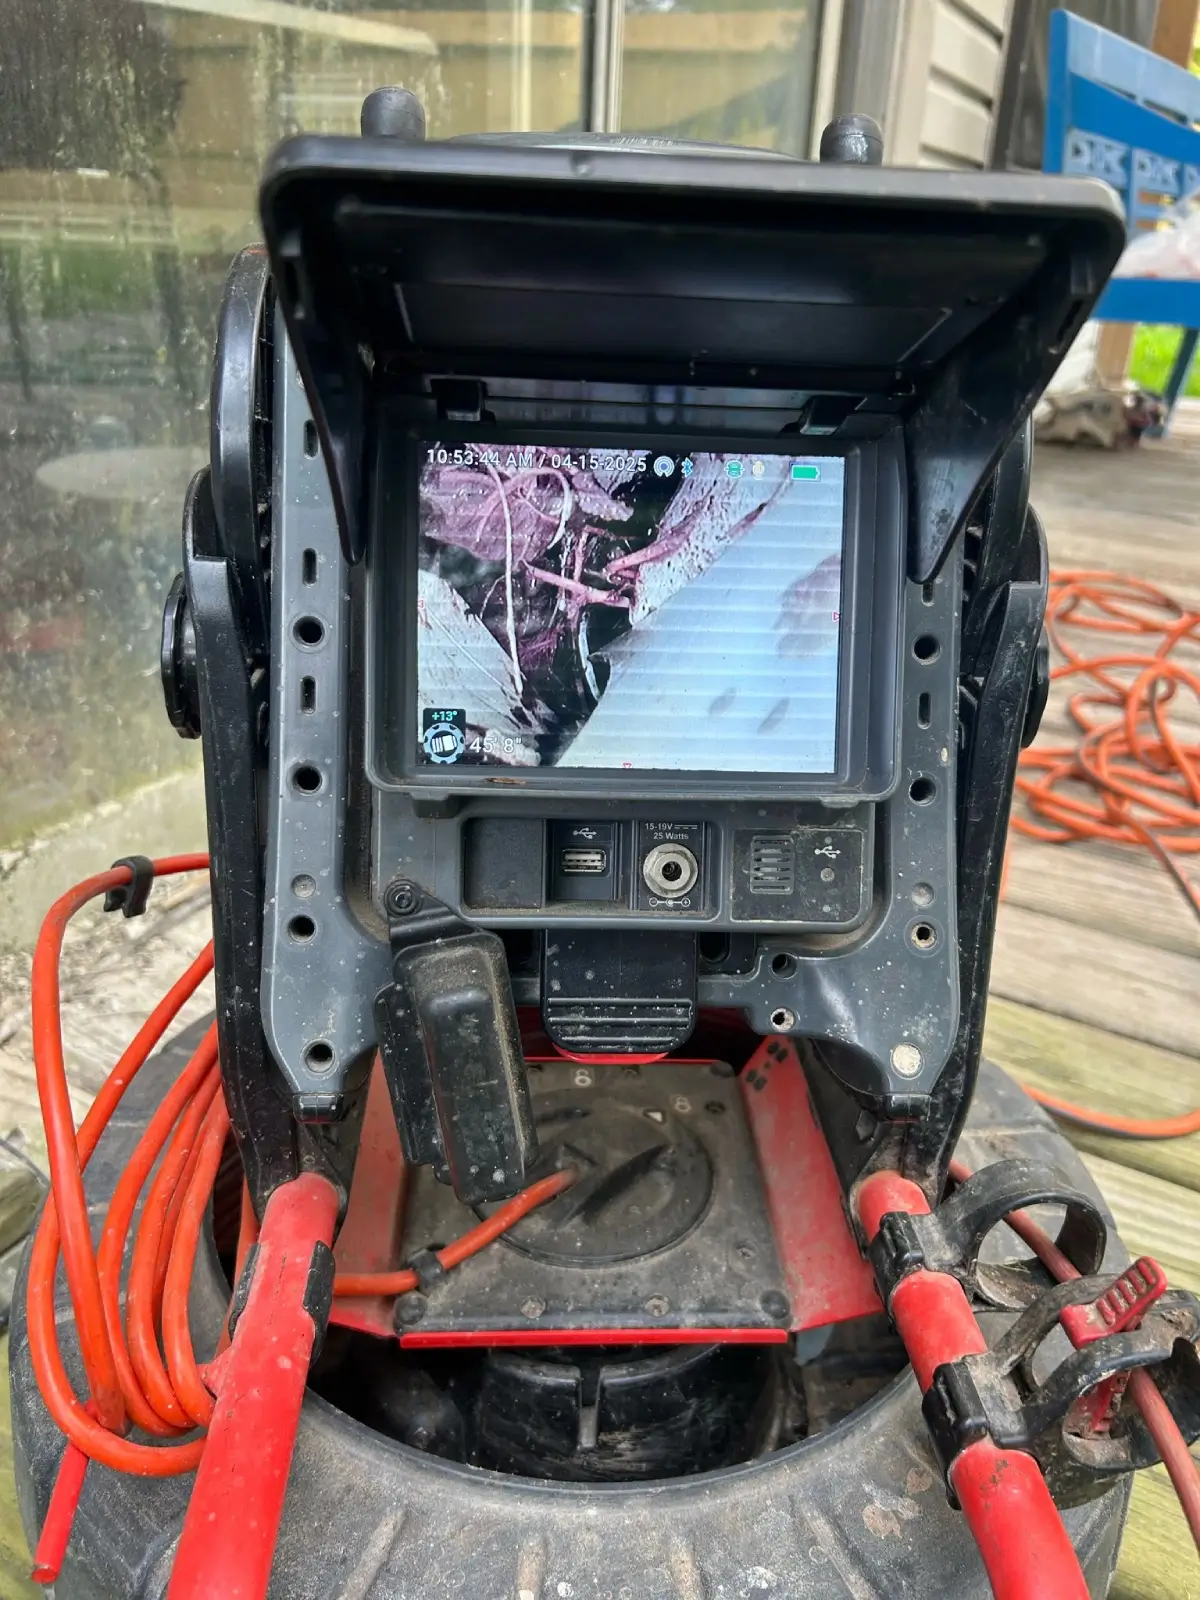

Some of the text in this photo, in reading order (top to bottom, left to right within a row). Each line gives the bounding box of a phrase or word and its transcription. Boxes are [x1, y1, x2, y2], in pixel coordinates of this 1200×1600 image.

[427, 449, 500, 466] 10:53:44
[506, 452, 533, 468] AM
[551, 454, 647, 472] 04-15-2025
[645, 822, 673, 830] 15-19V
[653, 832, 689, 840] 25 Watts
